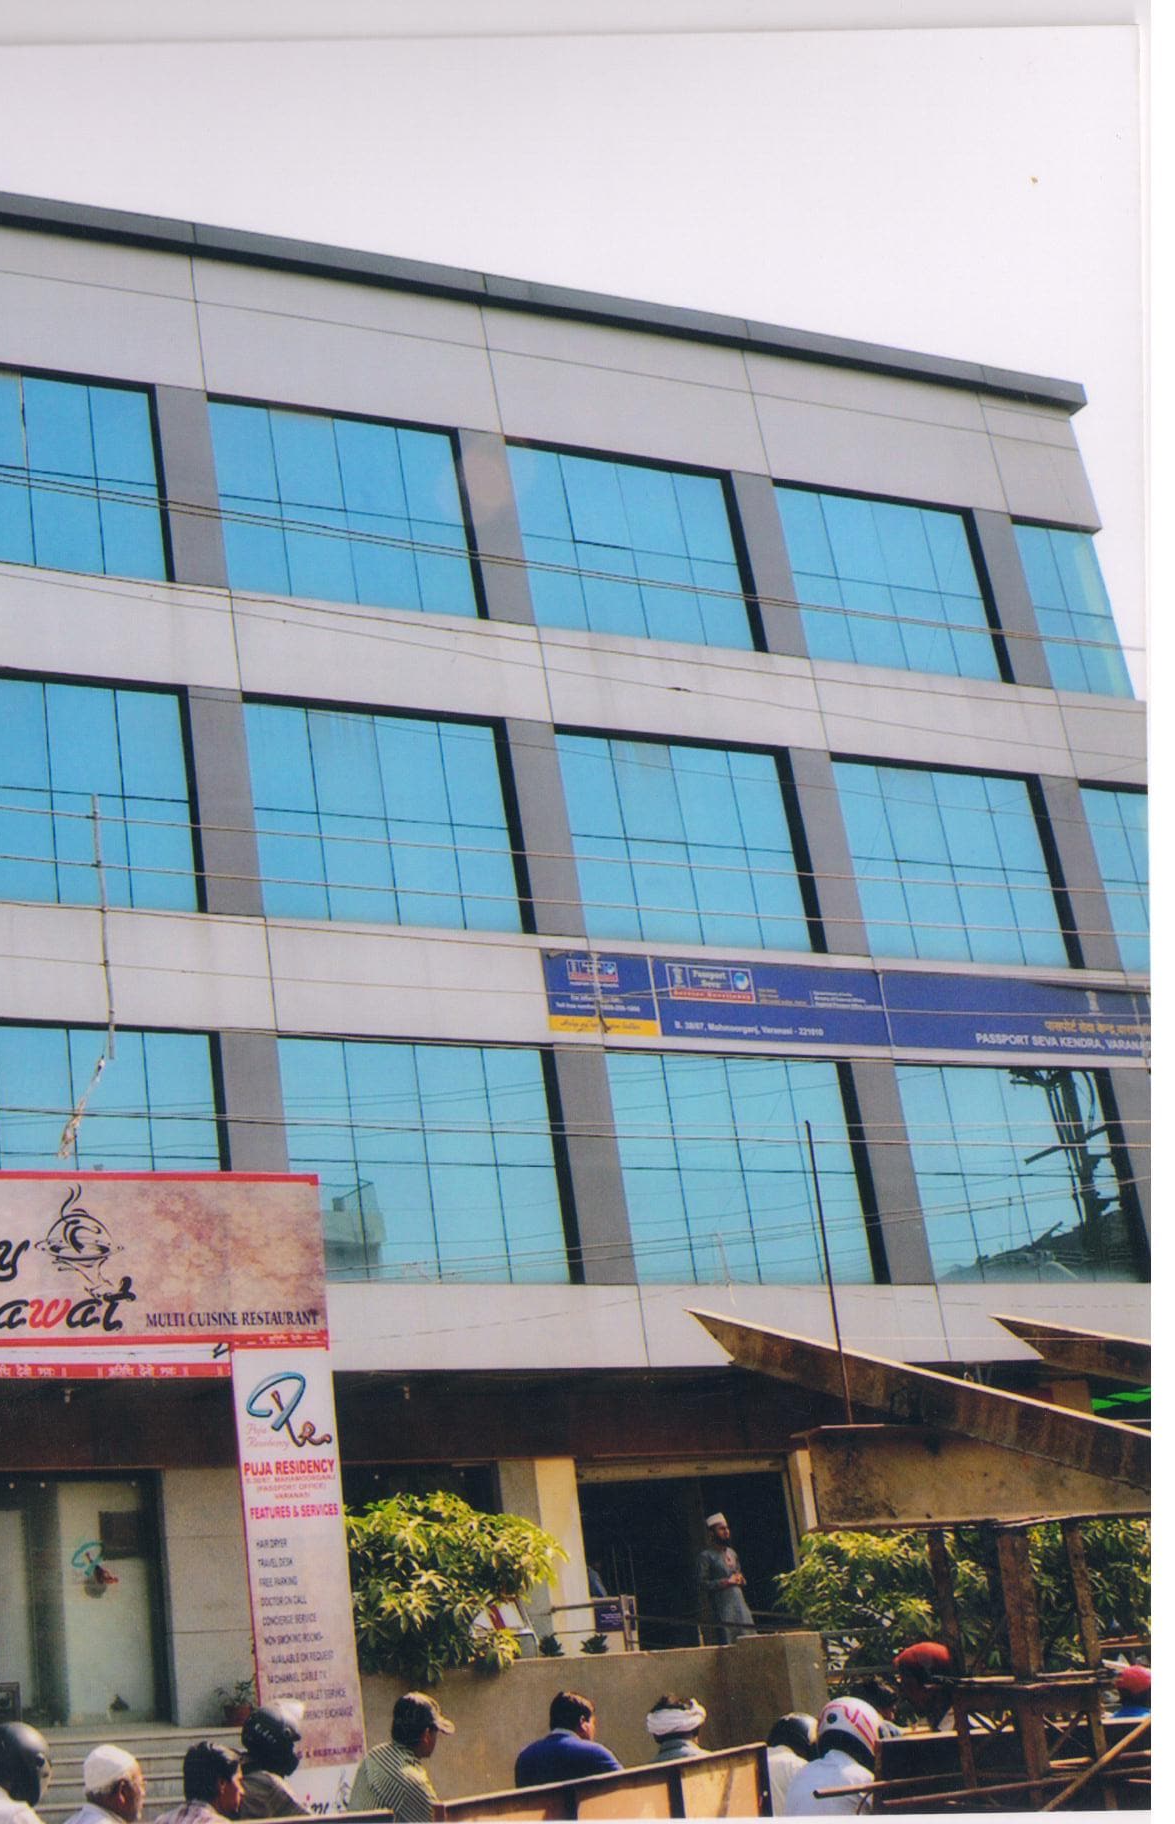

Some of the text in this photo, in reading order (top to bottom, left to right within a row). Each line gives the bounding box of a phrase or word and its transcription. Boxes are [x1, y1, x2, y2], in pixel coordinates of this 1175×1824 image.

[976, 1032, 1029, 1046] PASSPORT
[1032, 1035, 1059, 1047] SEVA
[1060, 1037, 1105, 1050] KENDRA,
[146, 1309, 319, 1327] MULTI CUISINE RESTAURANT
[244, 1459, 335, 1476] PUJA RESIDENCY
[250, 1503, 338, 1519] FEATURES & SERVICES
